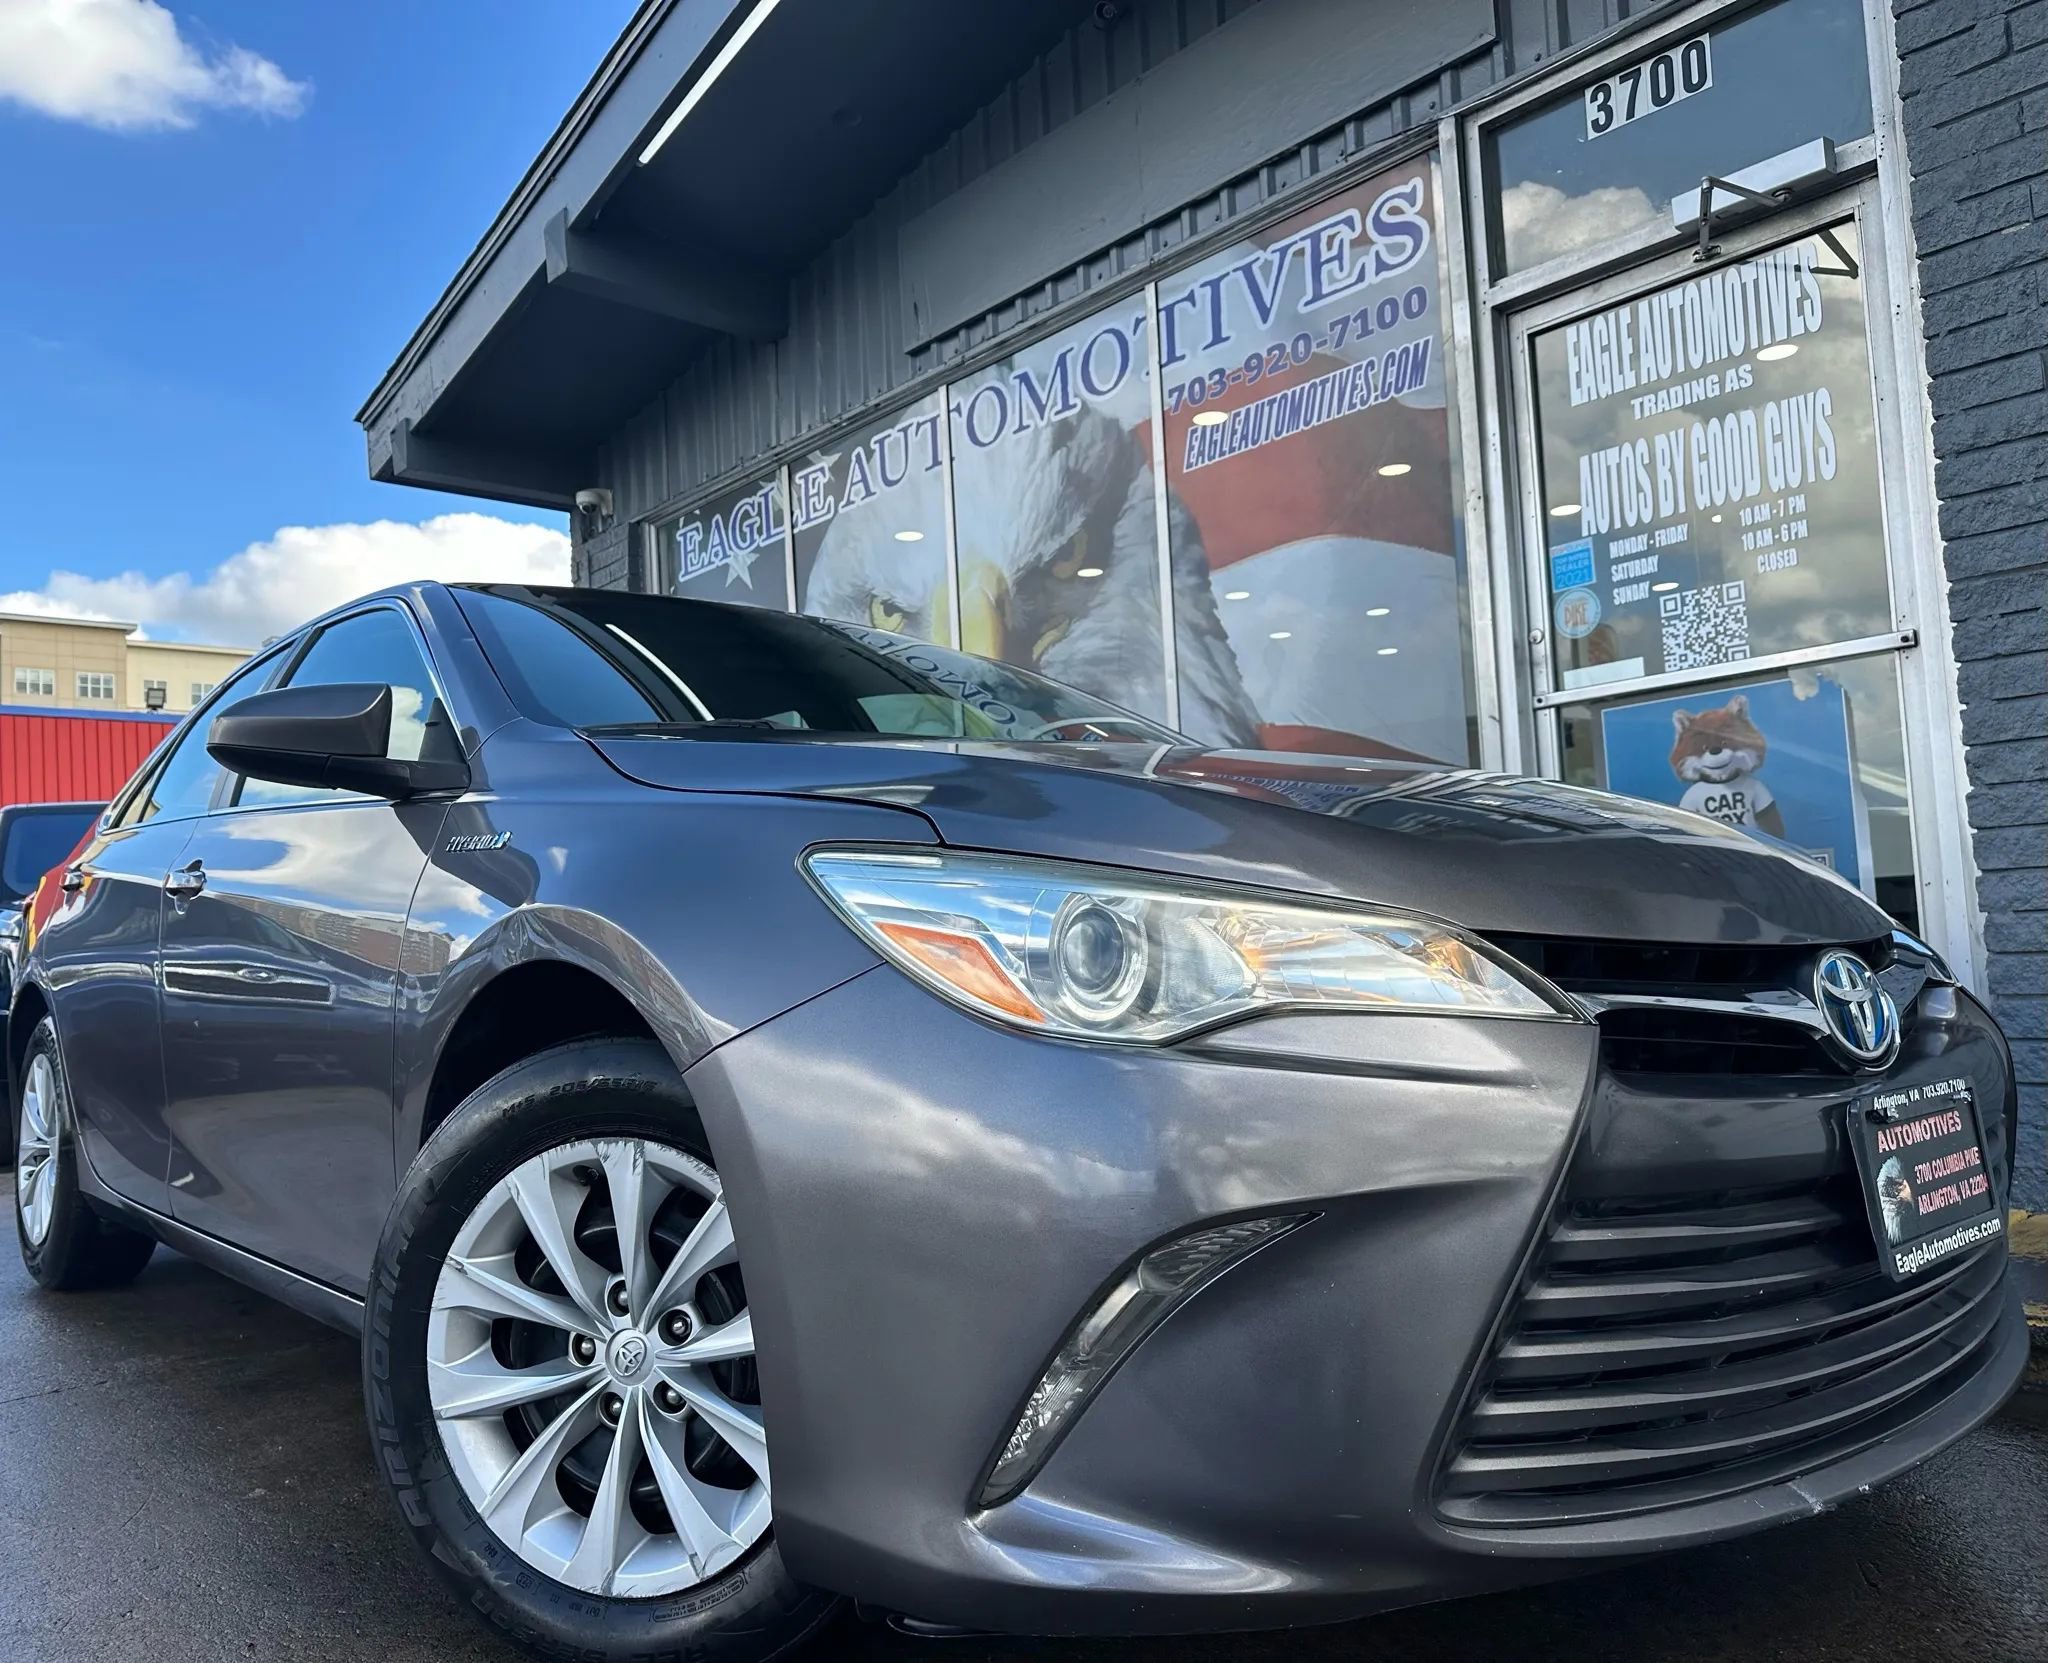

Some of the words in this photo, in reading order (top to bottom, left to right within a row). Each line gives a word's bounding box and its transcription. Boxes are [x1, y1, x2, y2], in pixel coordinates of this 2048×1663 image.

[1590, 40, 1708, 134] 3700
[1168, 286, 1428, 416] 703-920-7100
[1566, 306, 1637, 407] EAGLE
[1638, 241, 1823, 384] AUTOMOTIVES
[677, 462, 834, 582] EAGLE
[838, 176, 1430, 512] AUTOMOTIVES
[1183, 335, 1433, 474] EAGLEAUTOMOTIVES.COM
[1630, 374, 1720, 420] TRADING
[1724, 363, 1754, 393] AS
[1579, 438, 1653, 537] AUTOS
[1654, 428, 1687, 519] BY
[1690, 409, 1762, 511] GOOD
[1764, 387, 1837, 493] GUYS
[1609, 533, 1648, 559] MONDAY
[1655, 523, 1689, 547] FRIDAY
[1739, 507, 1753, 527] 10
[1754, 502, 1771, 523] AM
[1778, 499, 1785, 517] 7
[1788, 494, 1806, 515] PM
[1611, 555, 1659, 582] SATURDAY
[1741, 532, 1755, 551] 10
[1756, 528, 1773, 548] AM
[1781, 524, 1788, 542] 6
[1790, 520, 1808, 540] PM
[1555, 558, 1590, 573] DEALER
[1557, 569, 1591, 588] 2021
[1613, 581, 1650, 605] SUNDAY
[1757, 548, 1798, 574] CLOSED
[1704, 792, 1746, 814] CAR
[1873, 1093, 1909, 1110] Arlington,
[1909, 1089, 1920, 1101] VA
[1922, 1079, 1966, 1099] 703.920.7100
[1877, 1110, 1962, 1153] AUTOMOTIVES
[1914, 1161, 1932, 1185] 3700
[1932, 1151, 1965, 1179] COLUMBIA
[1964, 1146, 1981, 1167] PIKE
[1918, 1183, 1962, 1216] ARLINGTON,
[1960, 1179, 1972, 1200] VA
[1894, 1217, 2001, 1273] EagleAutomotives.com
